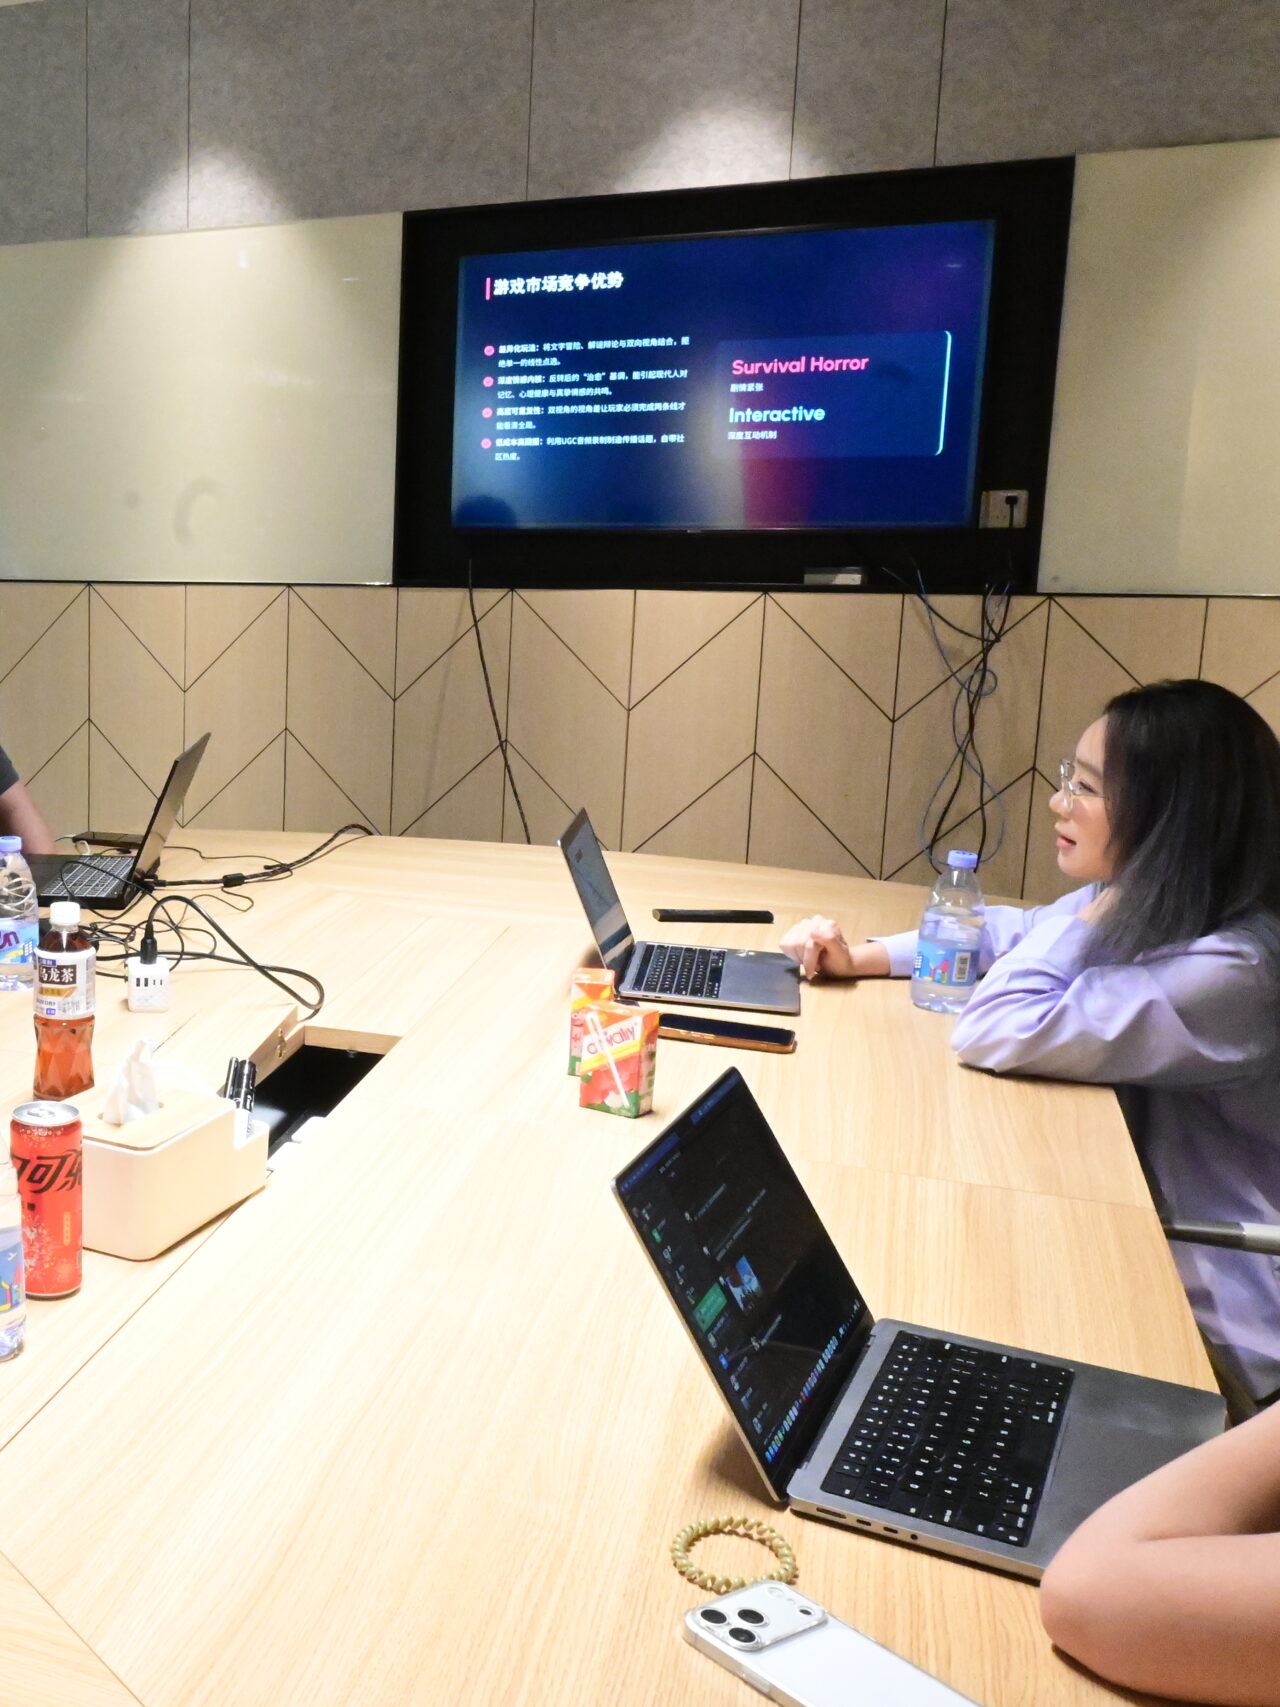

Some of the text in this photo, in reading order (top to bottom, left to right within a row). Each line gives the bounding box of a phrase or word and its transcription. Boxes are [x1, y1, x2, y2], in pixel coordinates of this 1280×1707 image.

[493, 271, 624, 295] 游戏市场竞争优势
[732, 356, 869, 375] Survival Horror
[729, 406, 826, 423] Interactive
